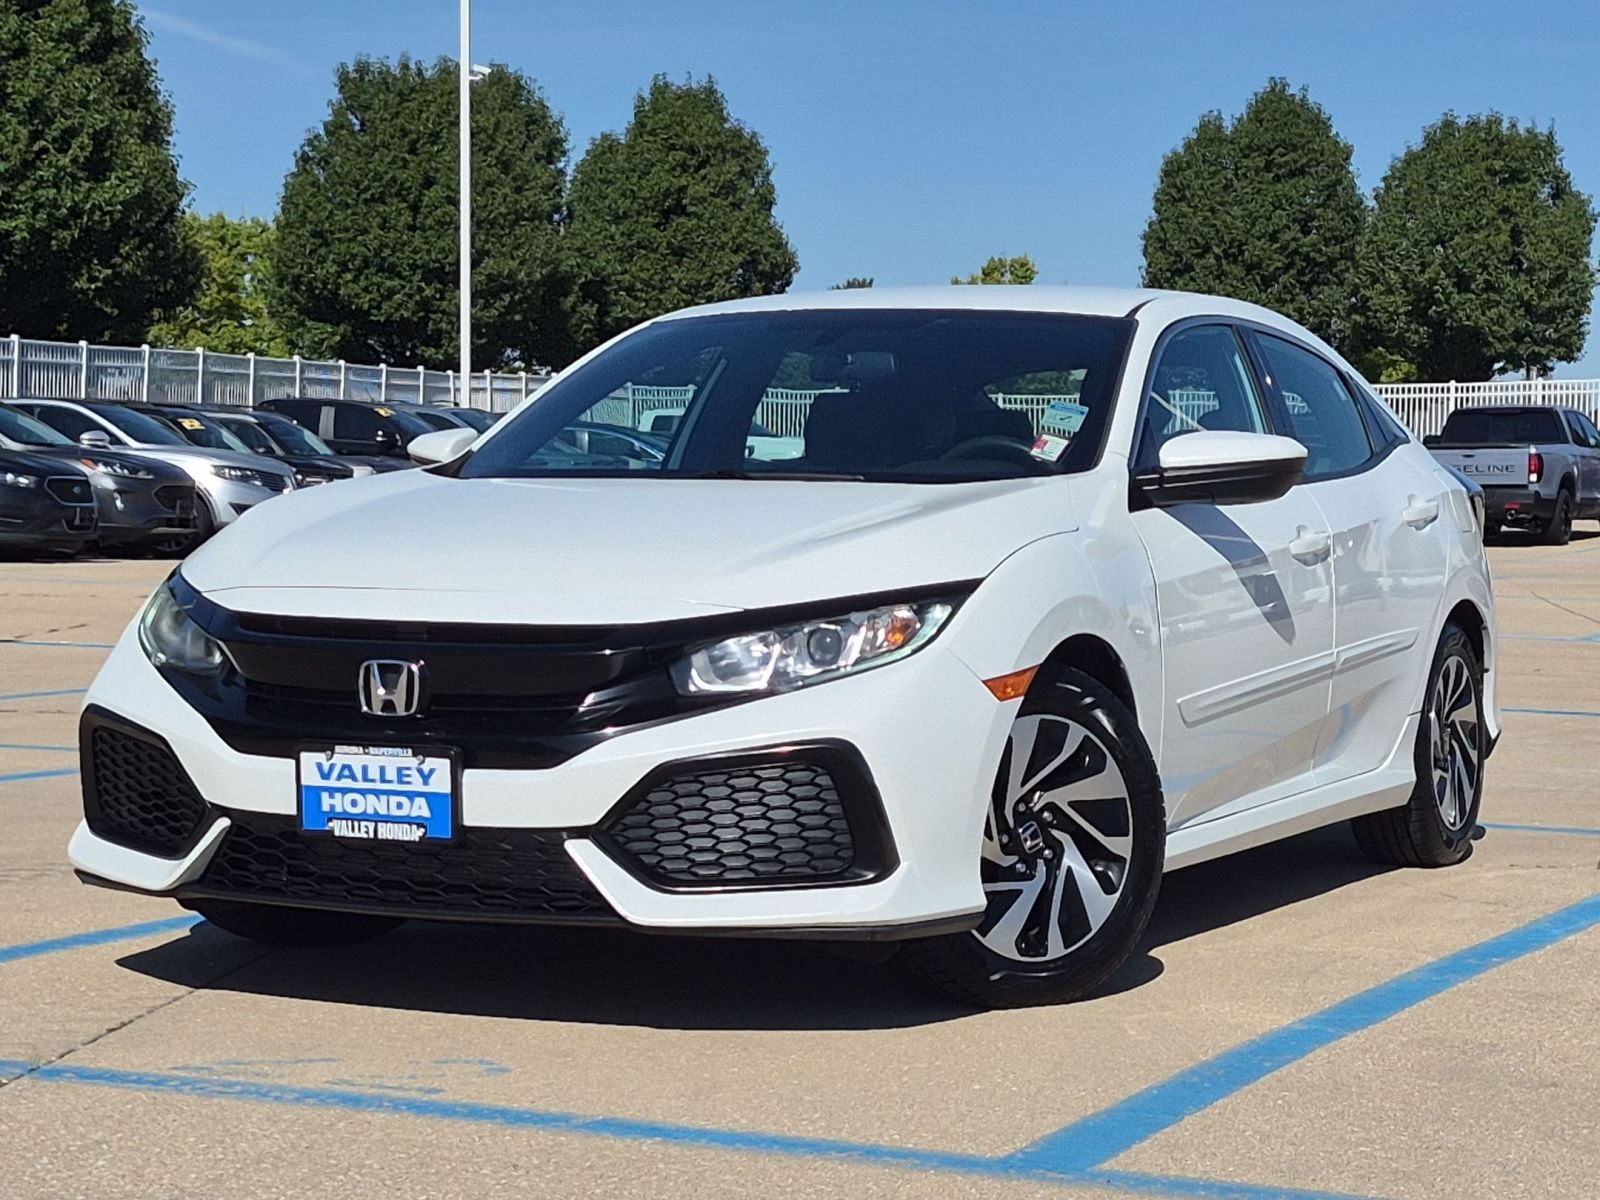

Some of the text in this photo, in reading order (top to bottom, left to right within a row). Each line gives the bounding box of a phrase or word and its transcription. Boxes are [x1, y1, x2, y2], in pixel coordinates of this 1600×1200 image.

[315, 761, 437, 787] VALLEY
[320, 791, 432, 819] HONDA
[332, 819, 419, 842] VALLEY HONDA
